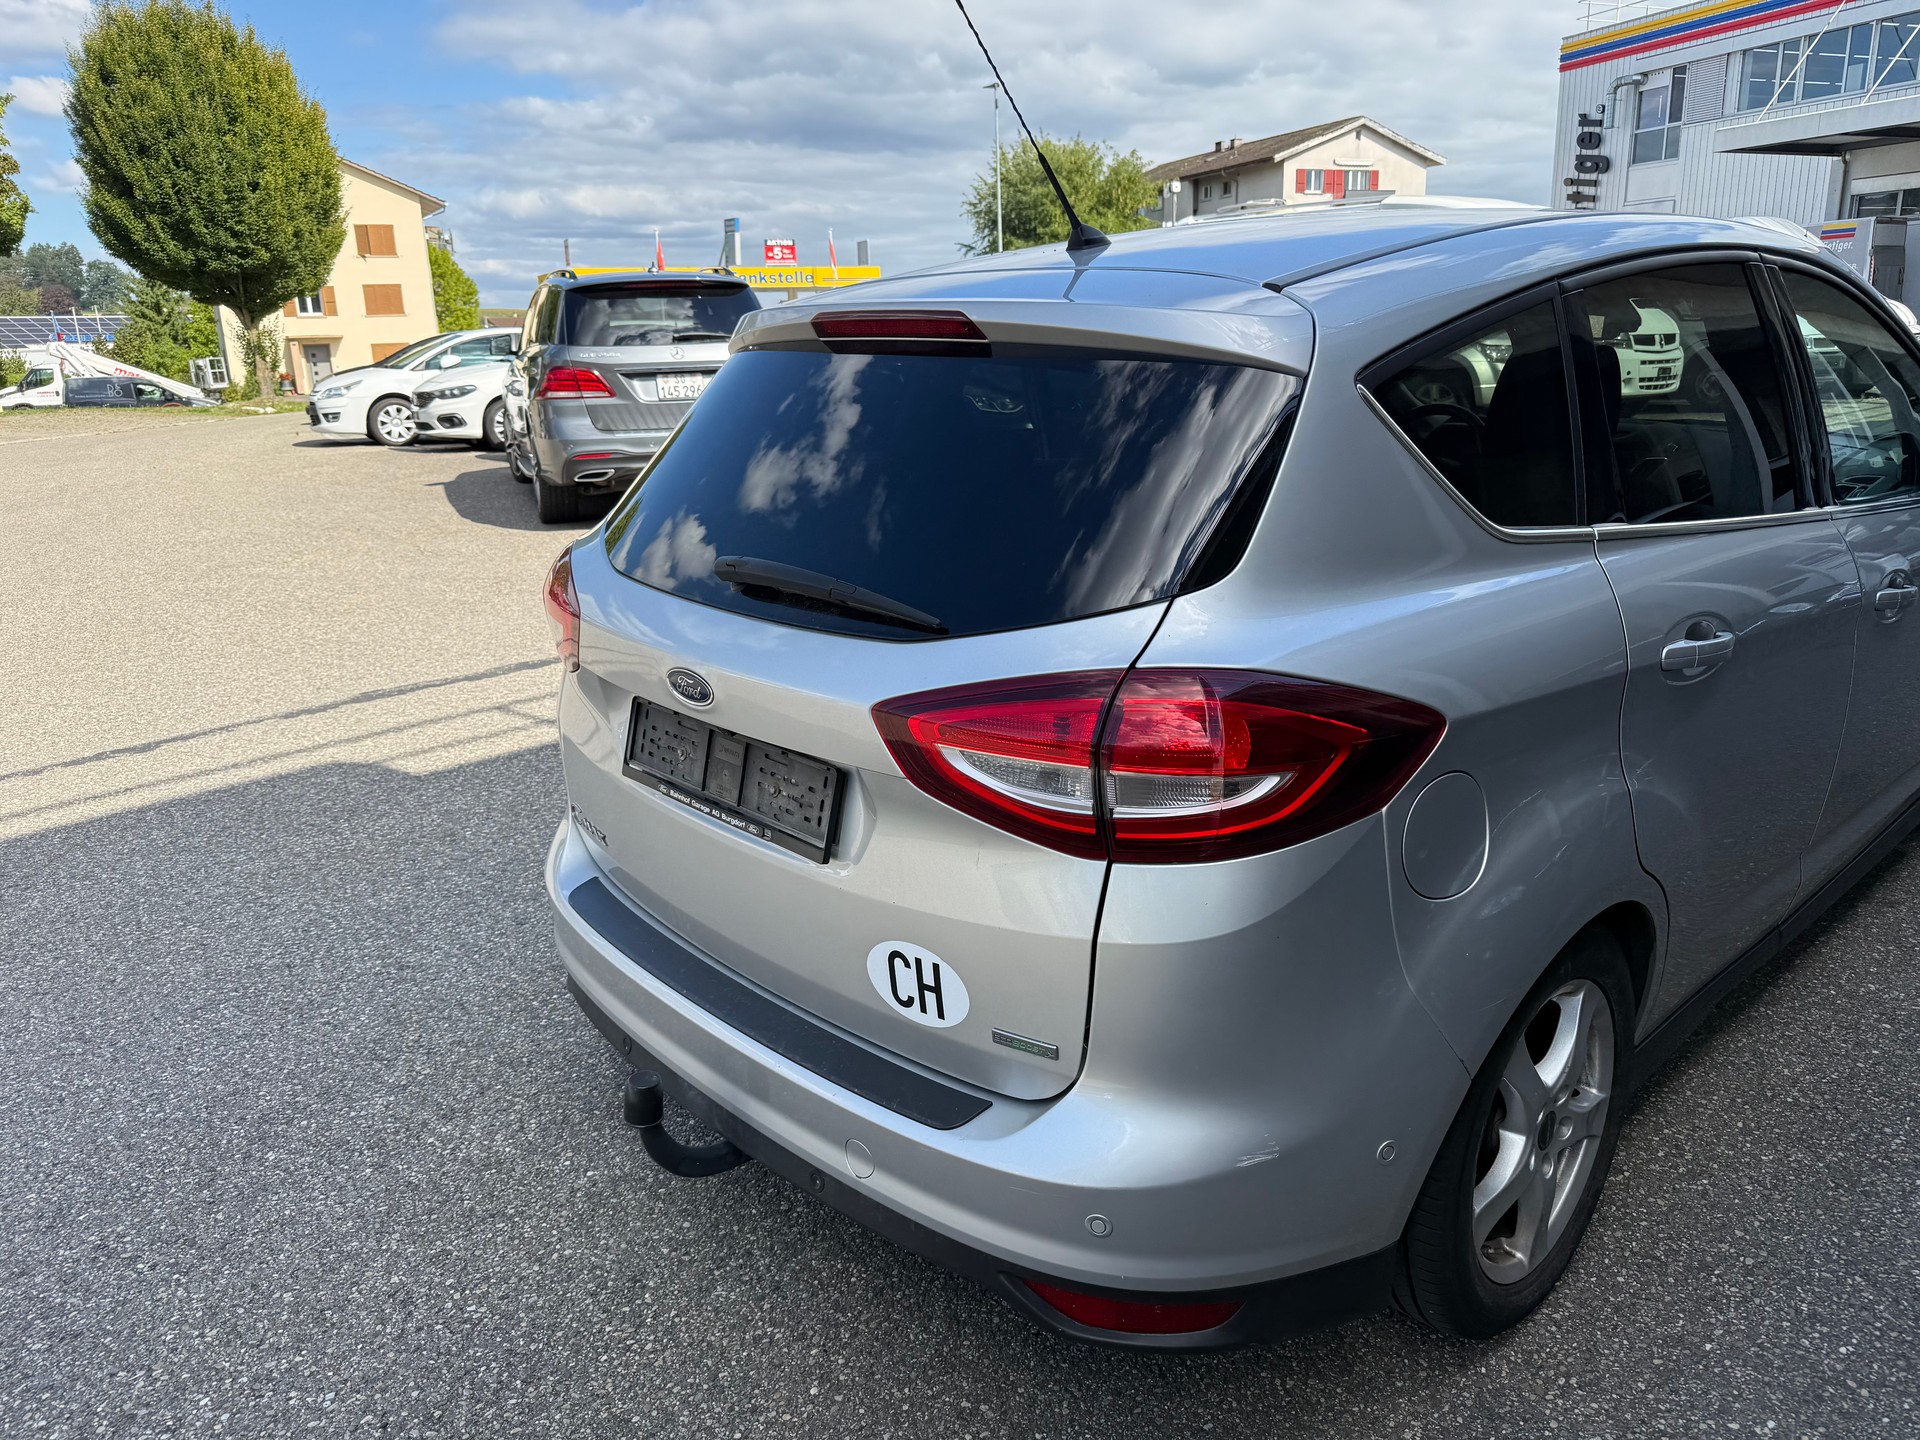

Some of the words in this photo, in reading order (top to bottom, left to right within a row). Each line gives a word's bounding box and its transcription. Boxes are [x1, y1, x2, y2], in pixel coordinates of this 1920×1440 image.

[734, 271, 815, 284] ankstelle
[661, 385, 681, 398] 145
[676, 675, 702, 699] Ford
[670, 789, 691, 804] Bahnhof
[691, 799, 711, 813] Garage
[711, 809, 720, 817] AG
[721, 813, 746, 829] Burgdorf
[887, 949, 946, 1021] CH
